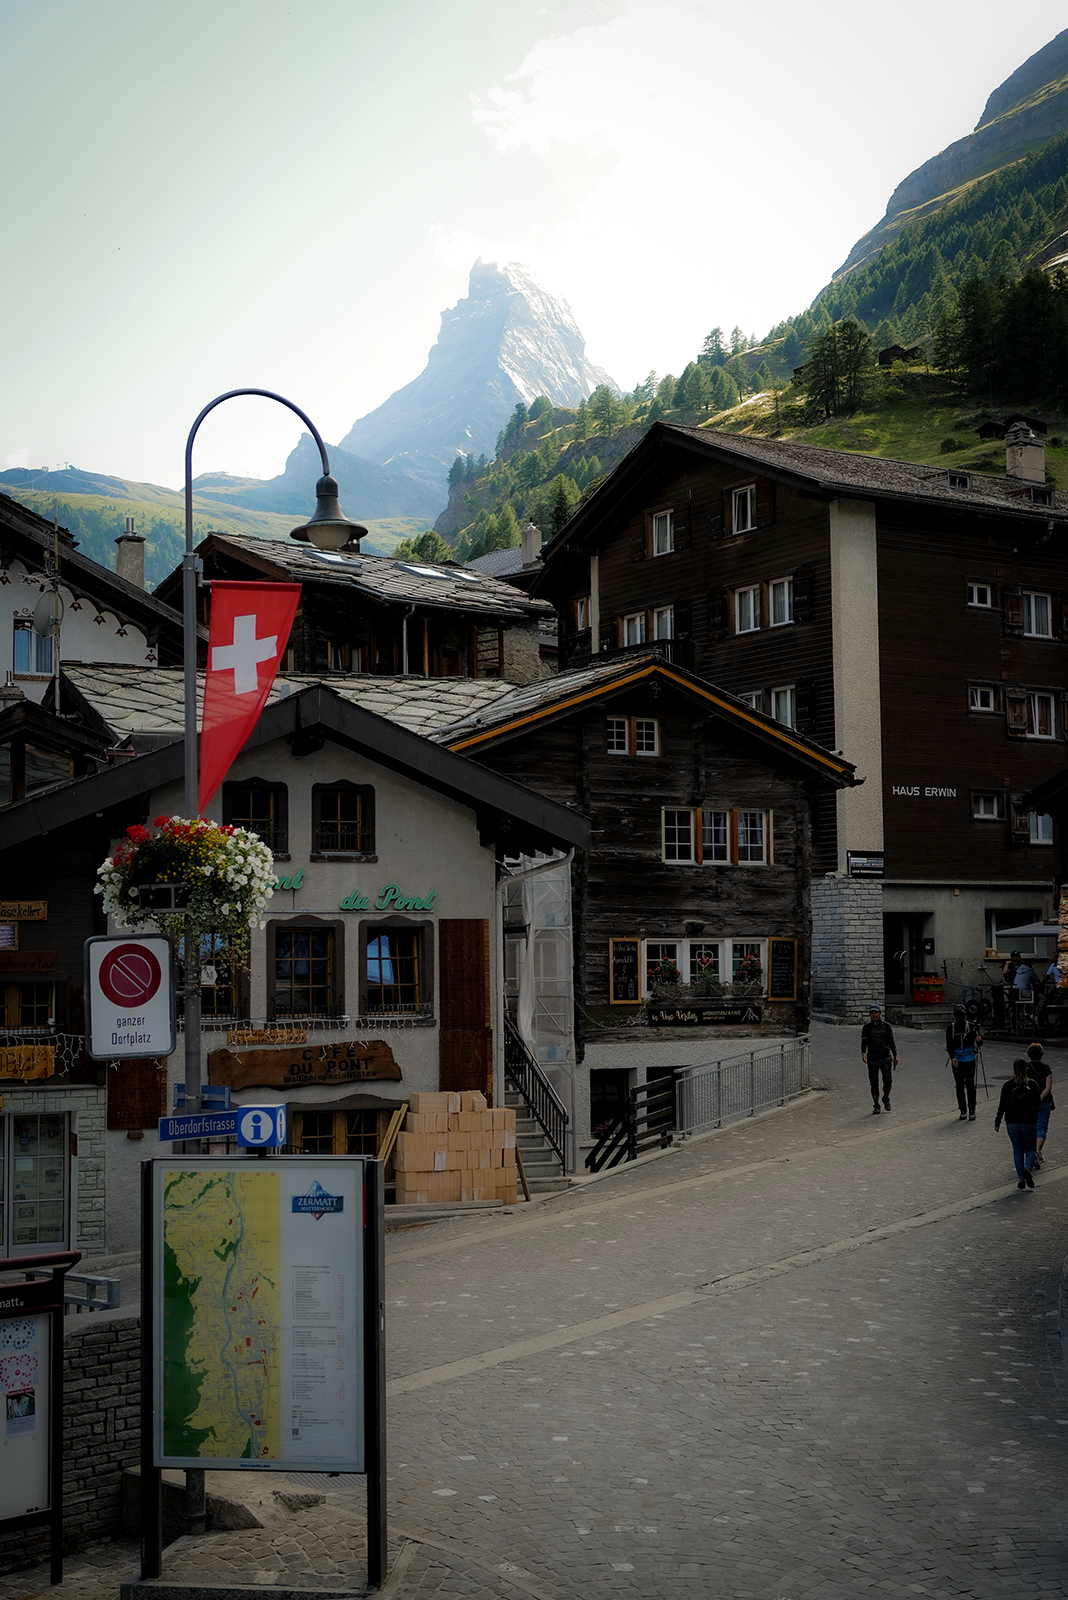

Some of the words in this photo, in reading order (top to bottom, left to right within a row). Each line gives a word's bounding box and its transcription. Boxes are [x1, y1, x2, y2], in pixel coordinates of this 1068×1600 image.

[892, 785, 921, 797] HAUS
[924, 786, 957, 798] ERWIN
[341, 889, 371, 911] du
[375, 883, 437, 911] Pont
[116, 1016, 146, 1029] ganzer
[111, 1031, 152, 1047] Dorfplatz
[290, 1062, 313, 1076] DU
[326, 1058, 371, 1073] PONT
[168, 1117, 236, 1136] Oberdorfstrasse
[297, 1197, 338, 1206] ZERMATT
